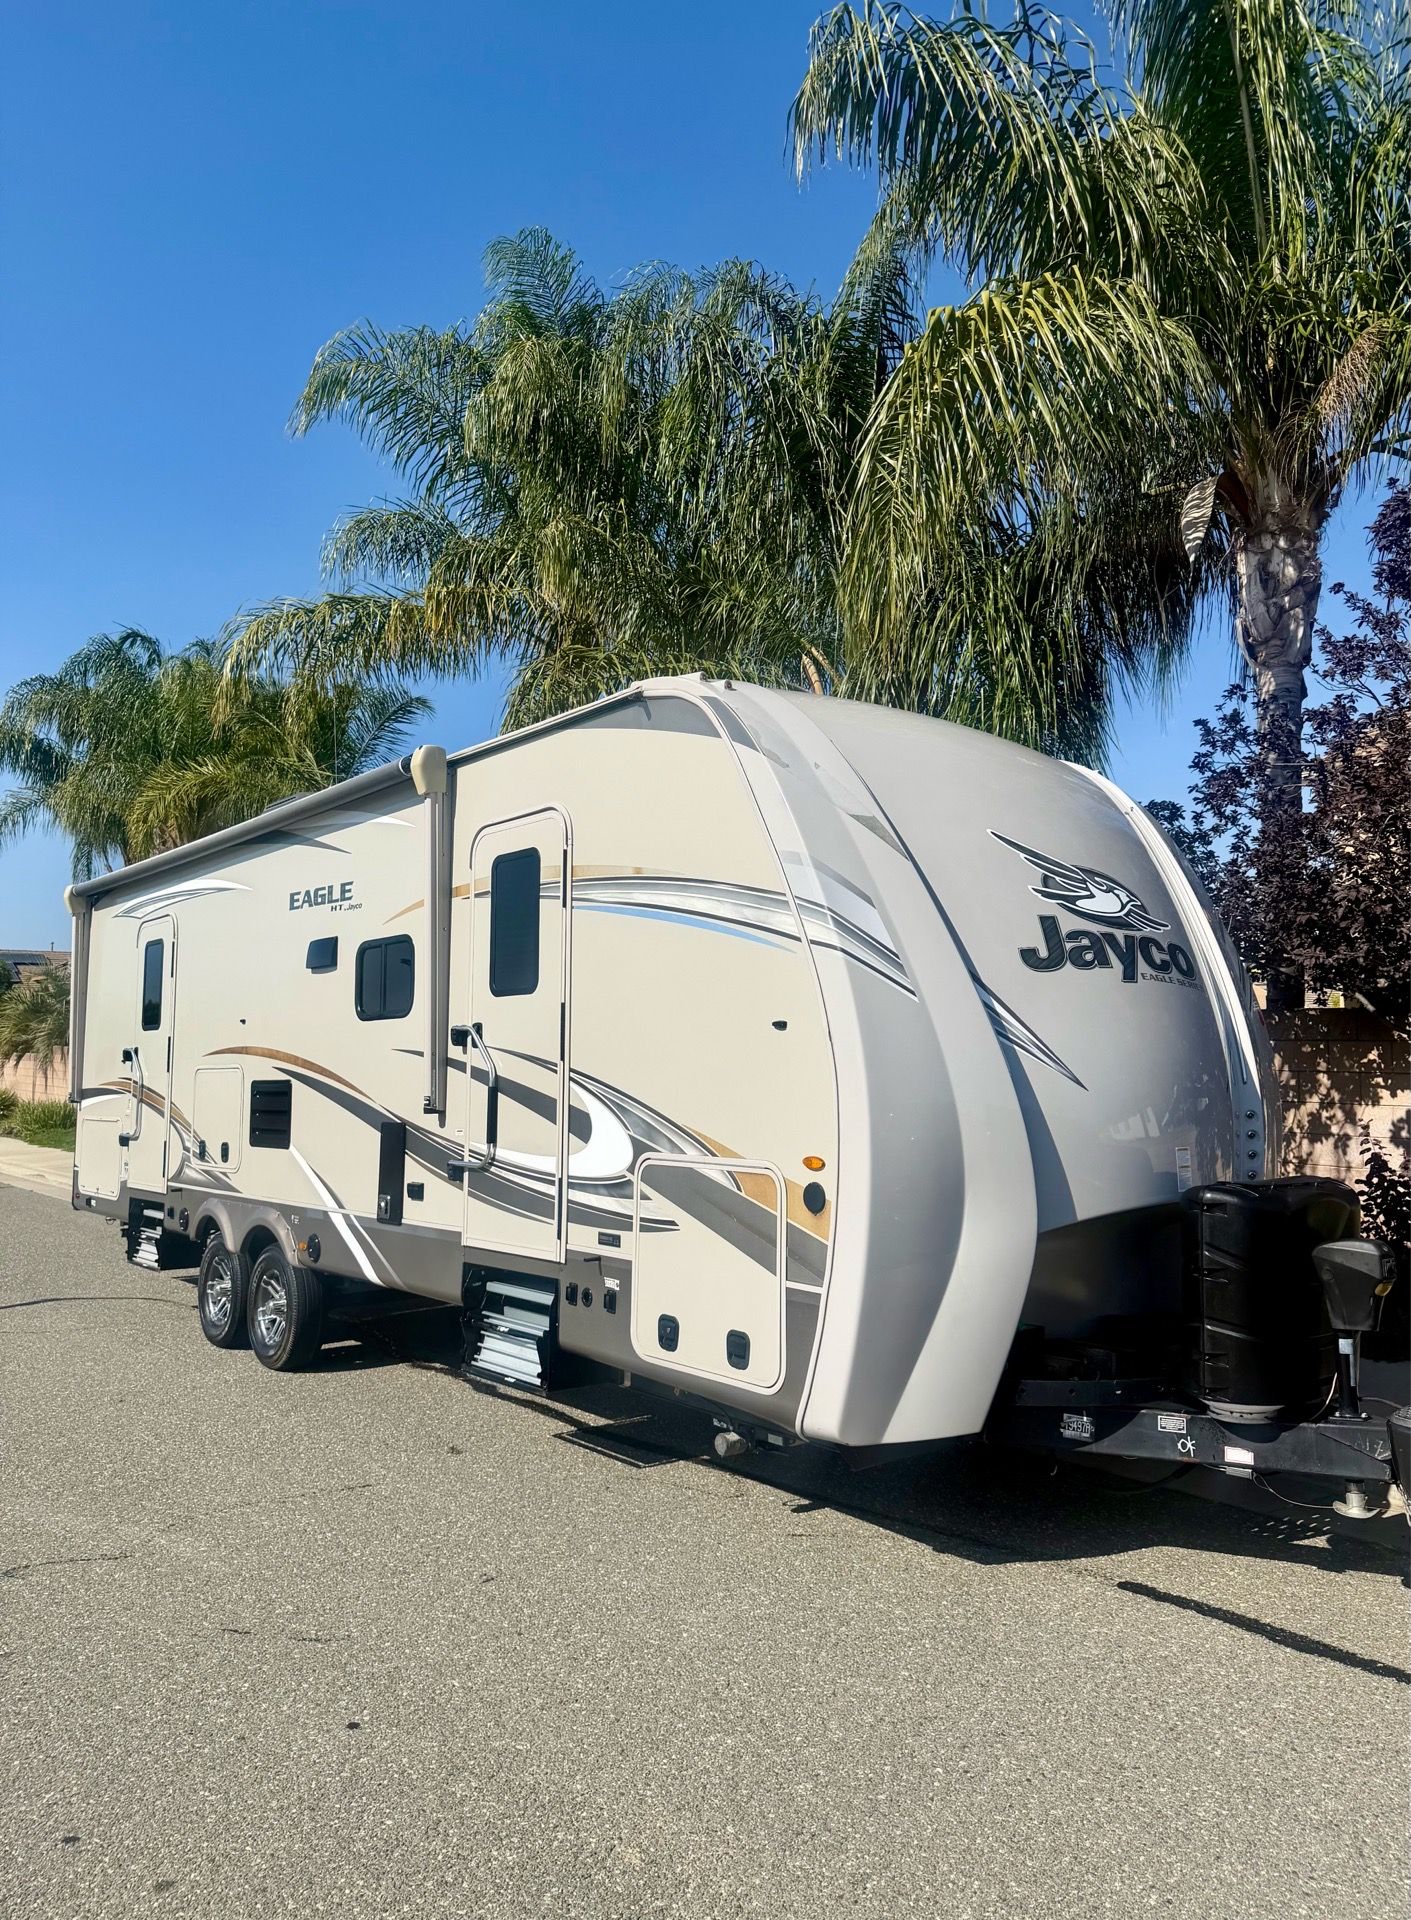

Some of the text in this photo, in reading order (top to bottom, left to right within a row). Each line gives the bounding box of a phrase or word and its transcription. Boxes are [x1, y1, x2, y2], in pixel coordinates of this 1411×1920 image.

[289, 881, 354, 911] EAGLE
[330, 904, 344, 912] HT
[1018, 914, 1197, 983] Jayco
[1140, 972, 1177, 984] EAGLE
